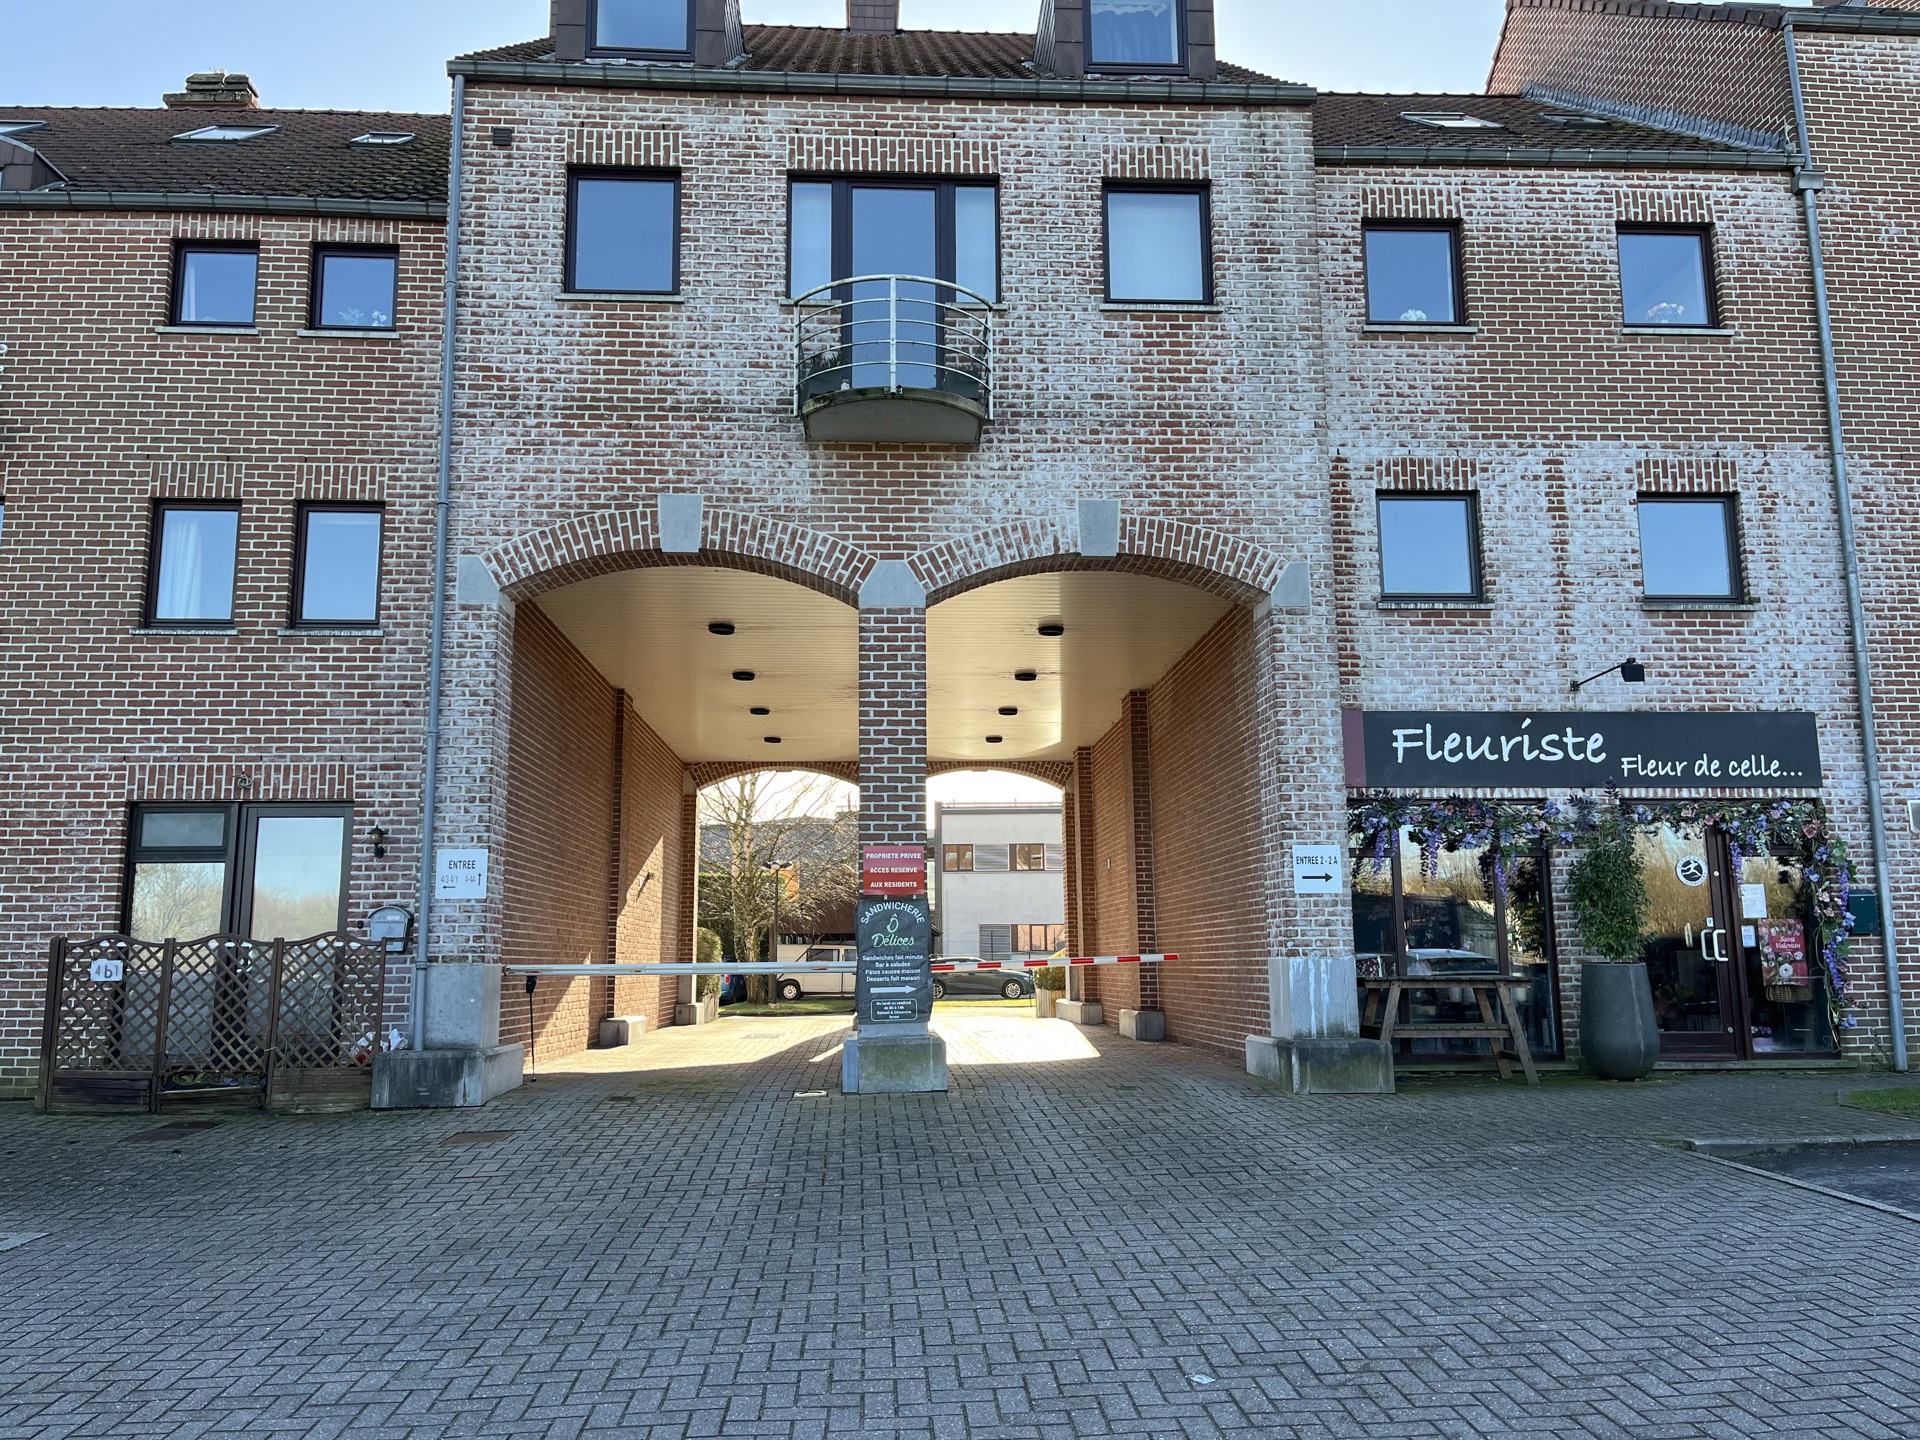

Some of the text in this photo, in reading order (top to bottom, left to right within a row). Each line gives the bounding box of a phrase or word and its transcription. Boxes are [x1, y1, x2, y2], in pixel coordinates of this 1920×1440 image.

[1392, 717, 1607, 763] Fleuriste
[1620, 753, 1803, 777] Fleur de celle...
[449, 860, 476, 869] ENTREE
[1296, 856, 1319, 865] ENTREE
[860, 901, 925, 924] SANDWICHERIE
[871, 933, 915, 947] Délices
